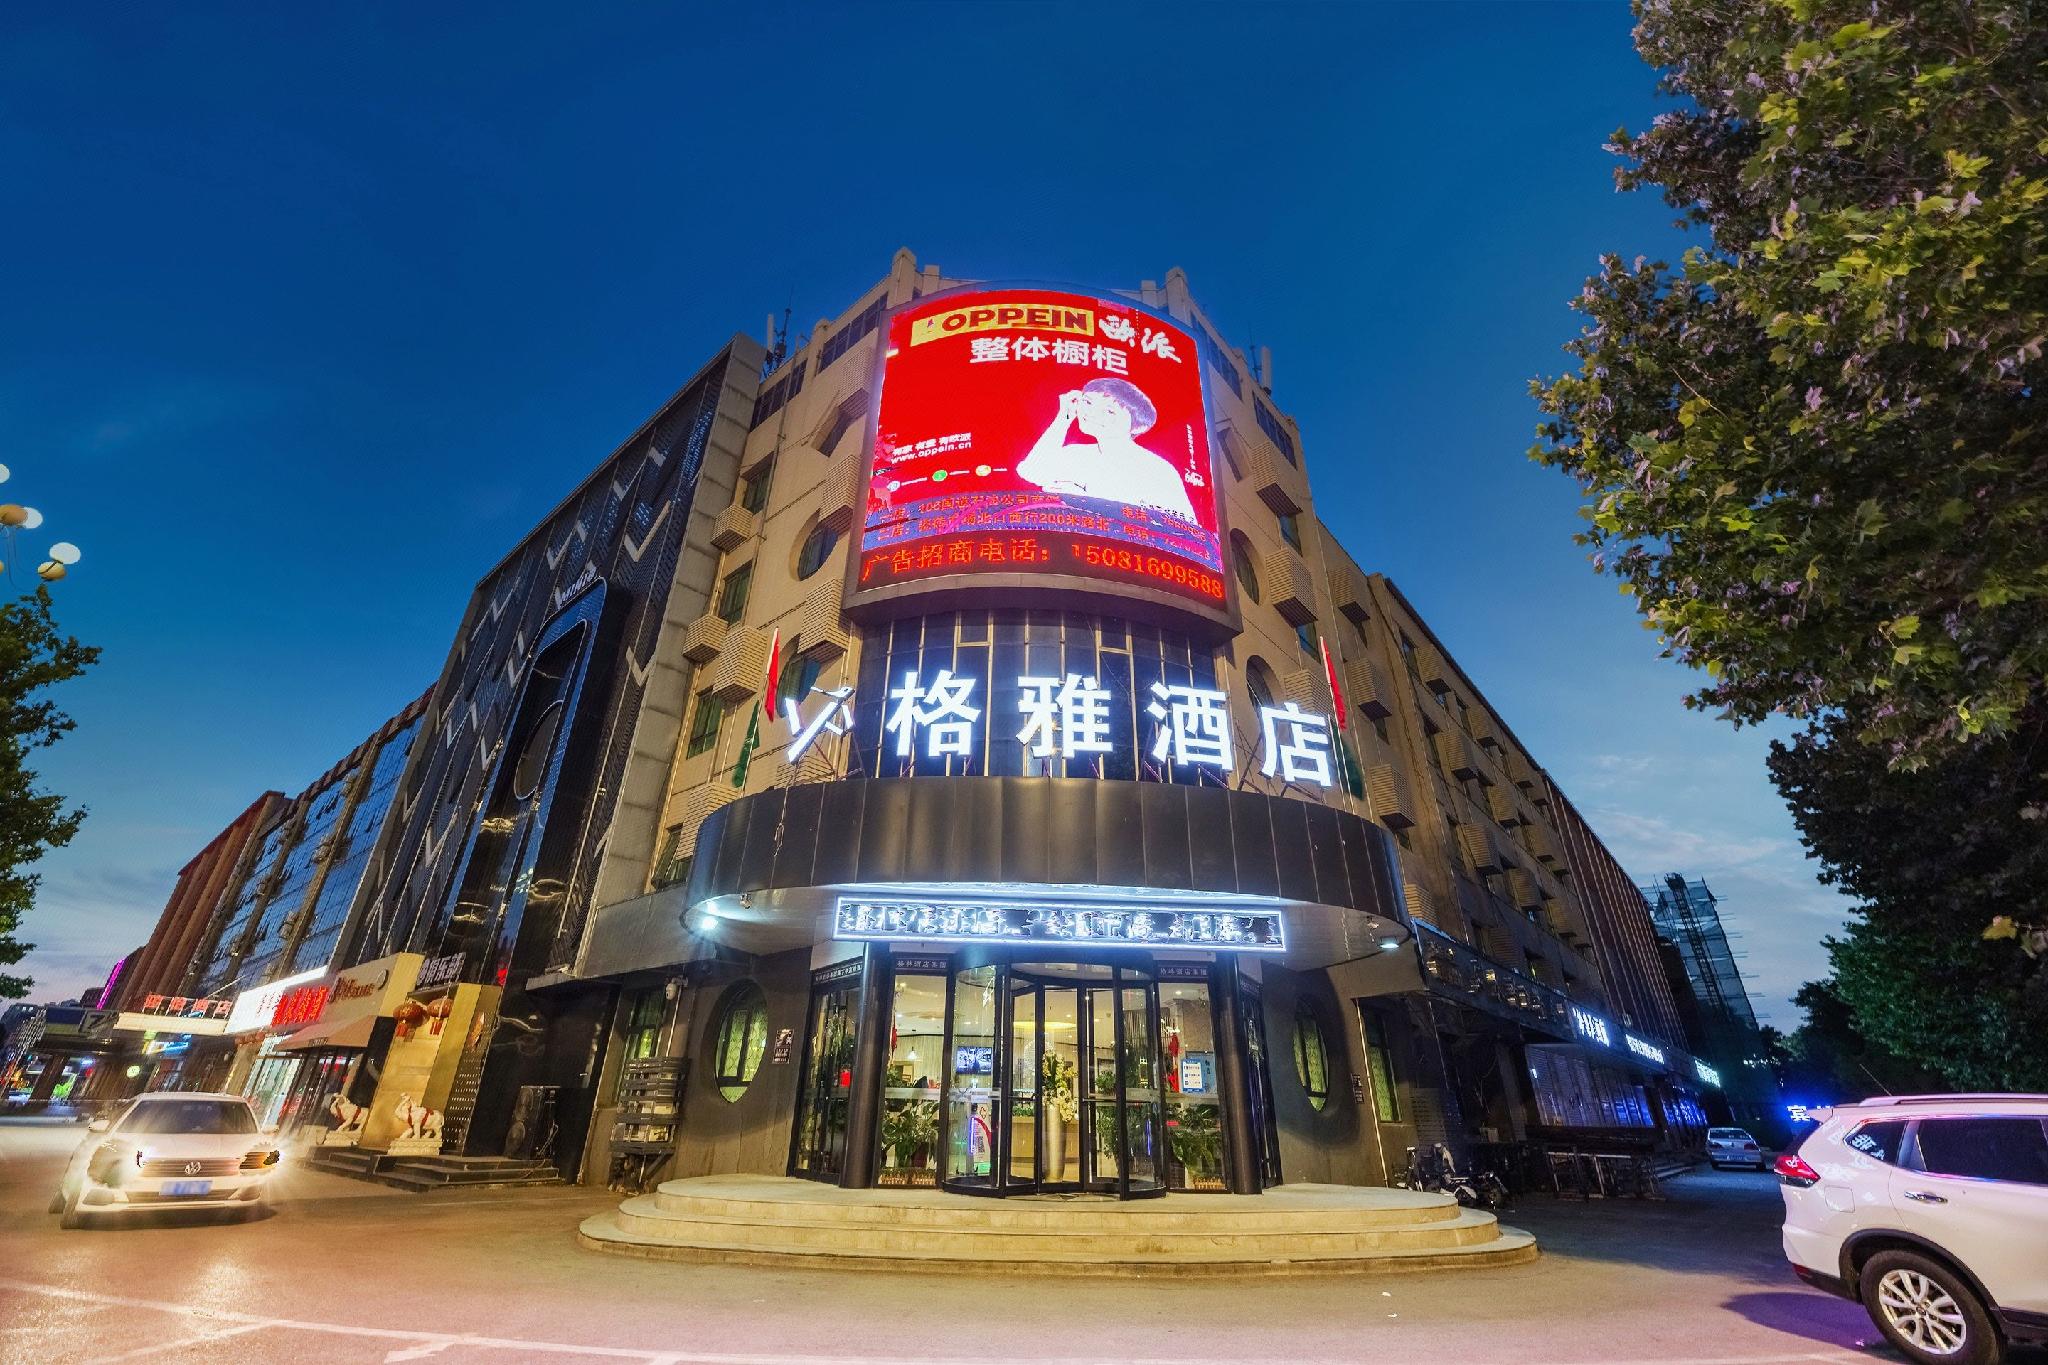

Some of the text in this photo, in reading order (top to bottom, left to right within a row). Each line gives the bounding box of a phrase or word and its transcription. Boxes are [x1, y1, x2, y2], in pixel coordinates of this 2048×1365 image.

[941, 307, 1089, 333] OPPEIN
[1098, 314, 1182, 363] 欧派
[969, 336, 1130, 375] 整体橱柜
[862, 537, 1051, 582] 广告招商电话:
[886, 668, 1333, 788] 格雅酒店
